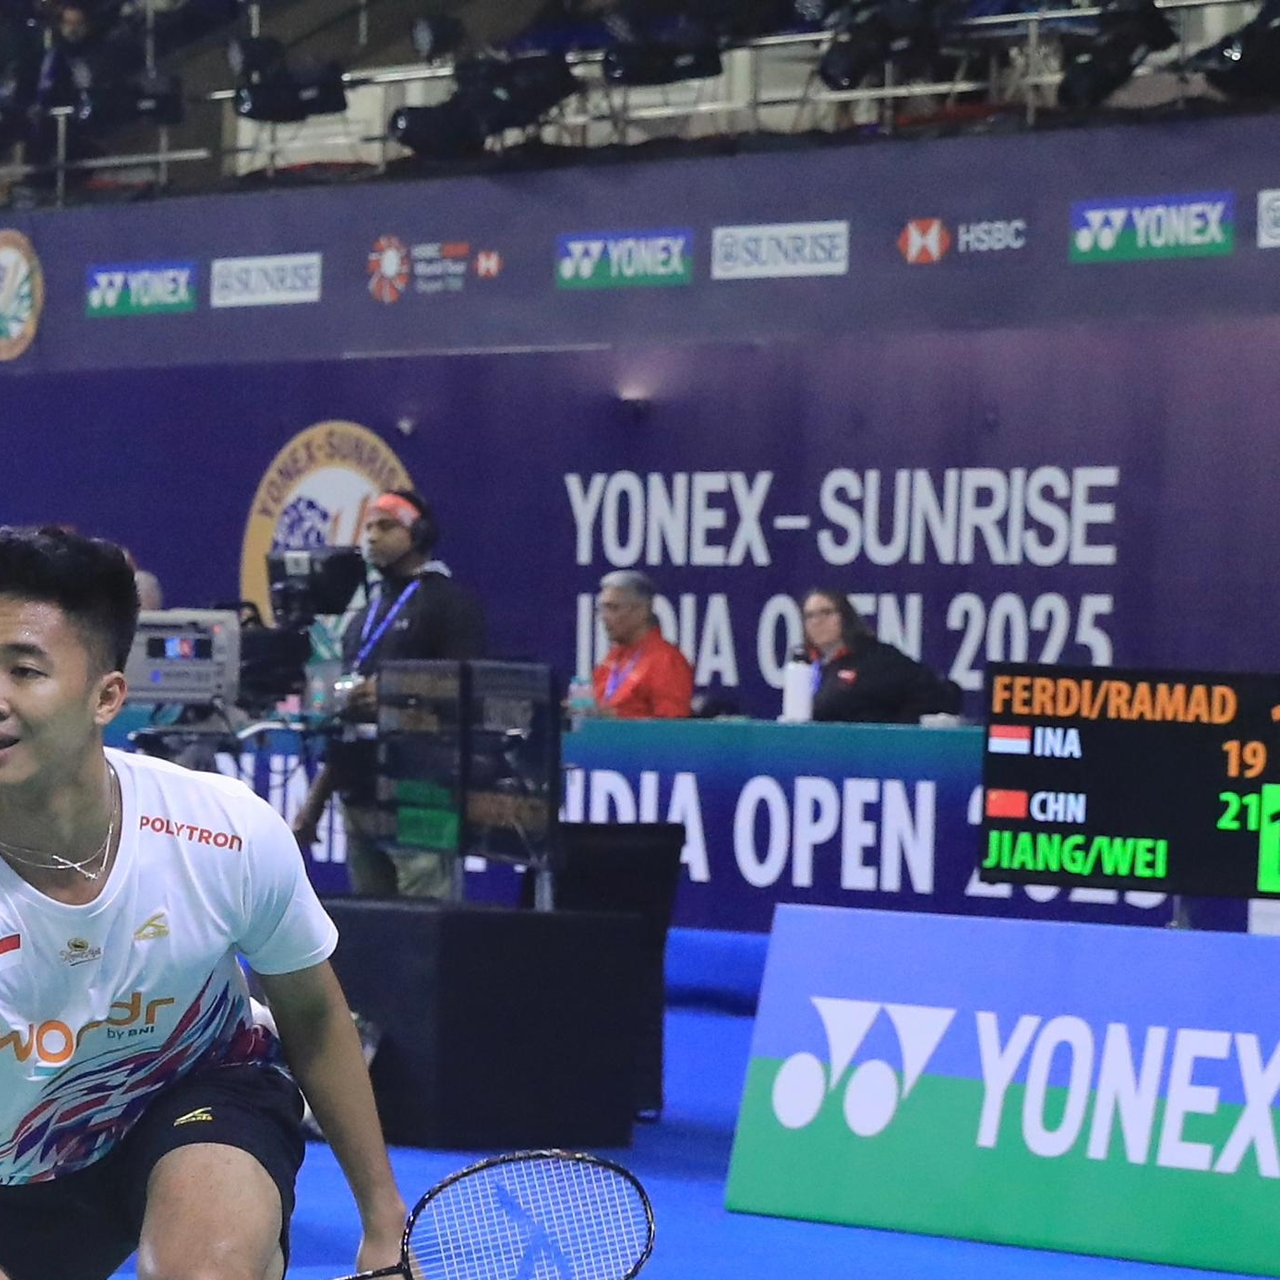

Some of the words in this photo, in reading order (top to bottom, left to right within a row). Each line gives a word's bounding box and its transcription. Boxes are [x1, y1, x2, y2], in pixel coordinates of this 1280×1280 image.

[957, 219, 1026, 252] HSBC
[1131, 201, 1226, 248] YONEX
[606, 234, 686, 278] YONEX
[740, 232, 842, 268] SUNRISE
[127, 267, 191, 306] YONEX
[563, 466, 1120, 567] YONEX-SUNRISE
[947, 592, 1115, 691] 2025
[991, 674, 1238, 725] FERDI/RAMAD
[1033, 726, 1083, 759] INA
[1221, 740, 1268, 779] 19
[139, 815, 243, 853] POLYTRON
[734, 773, 936, 896] OPEN
[1029, 791, 1087, 824] CHN
[1215, 791, 1260, 832] 21
[981, 829, 1169, 879] JIANG/WEI
[106, 1027, 125, 1040] by
[127, 1025, 155, 1037] BNI
[975, 1009, 1280, 1179] YONEX
